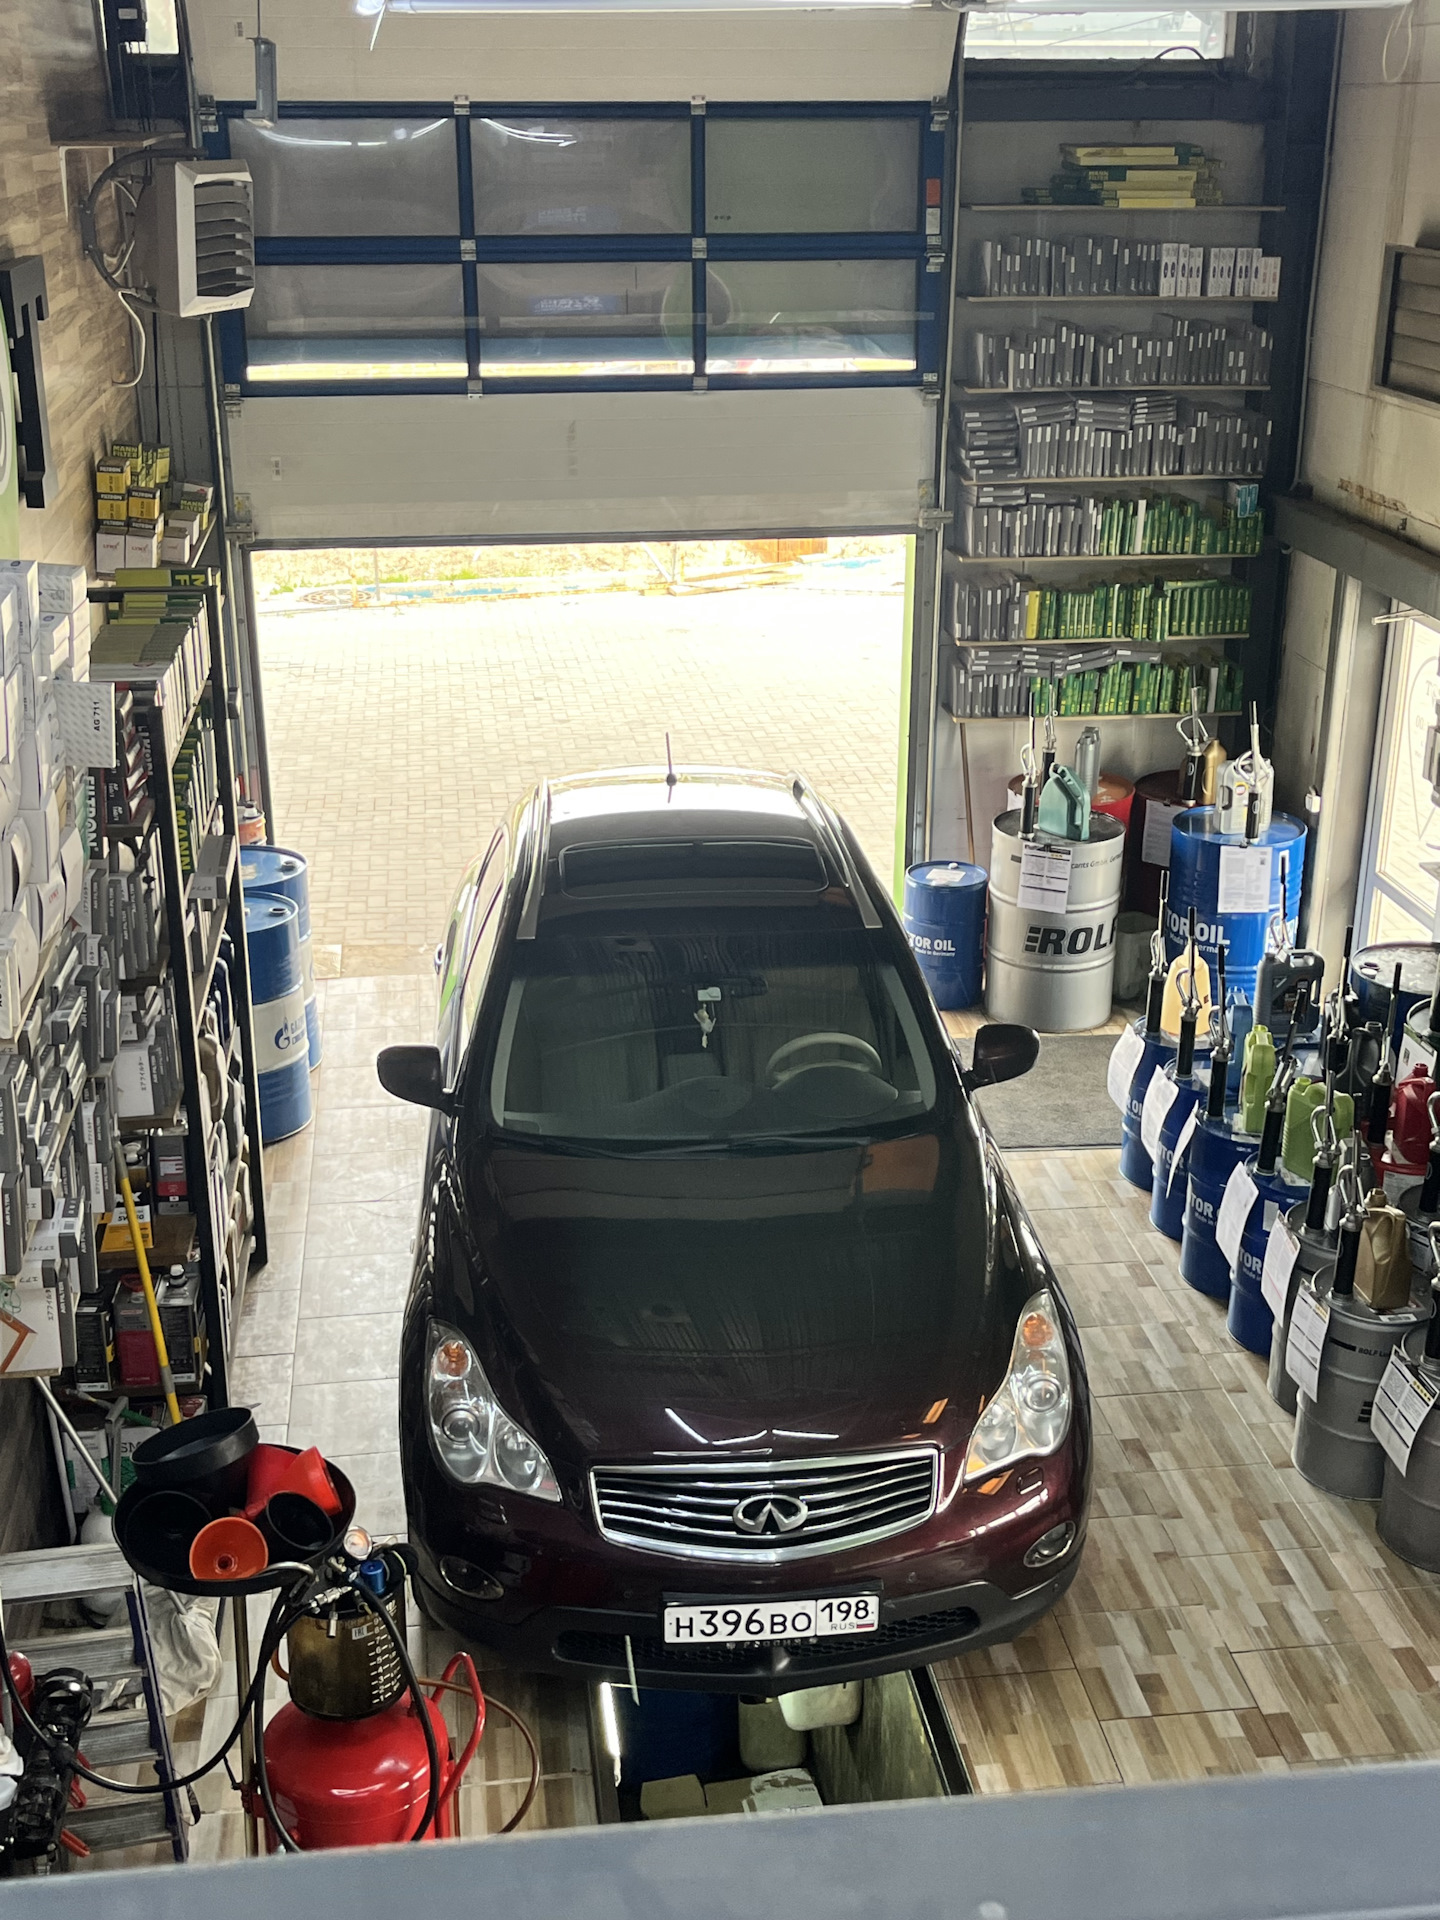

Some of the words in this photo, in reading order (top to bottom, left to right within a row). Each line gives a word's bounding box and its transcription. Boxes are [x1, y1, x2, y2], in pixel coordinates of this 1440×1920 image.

[93, 718, 100, 732] AG
[176, 810, 191, 871] MANN
[1194, 922, 1230, 945] OIL
[934, 939, 956, 951] OIL
[820, 1600, 869, 1622] 198
[831, 1621, 855, 1631] RUS
